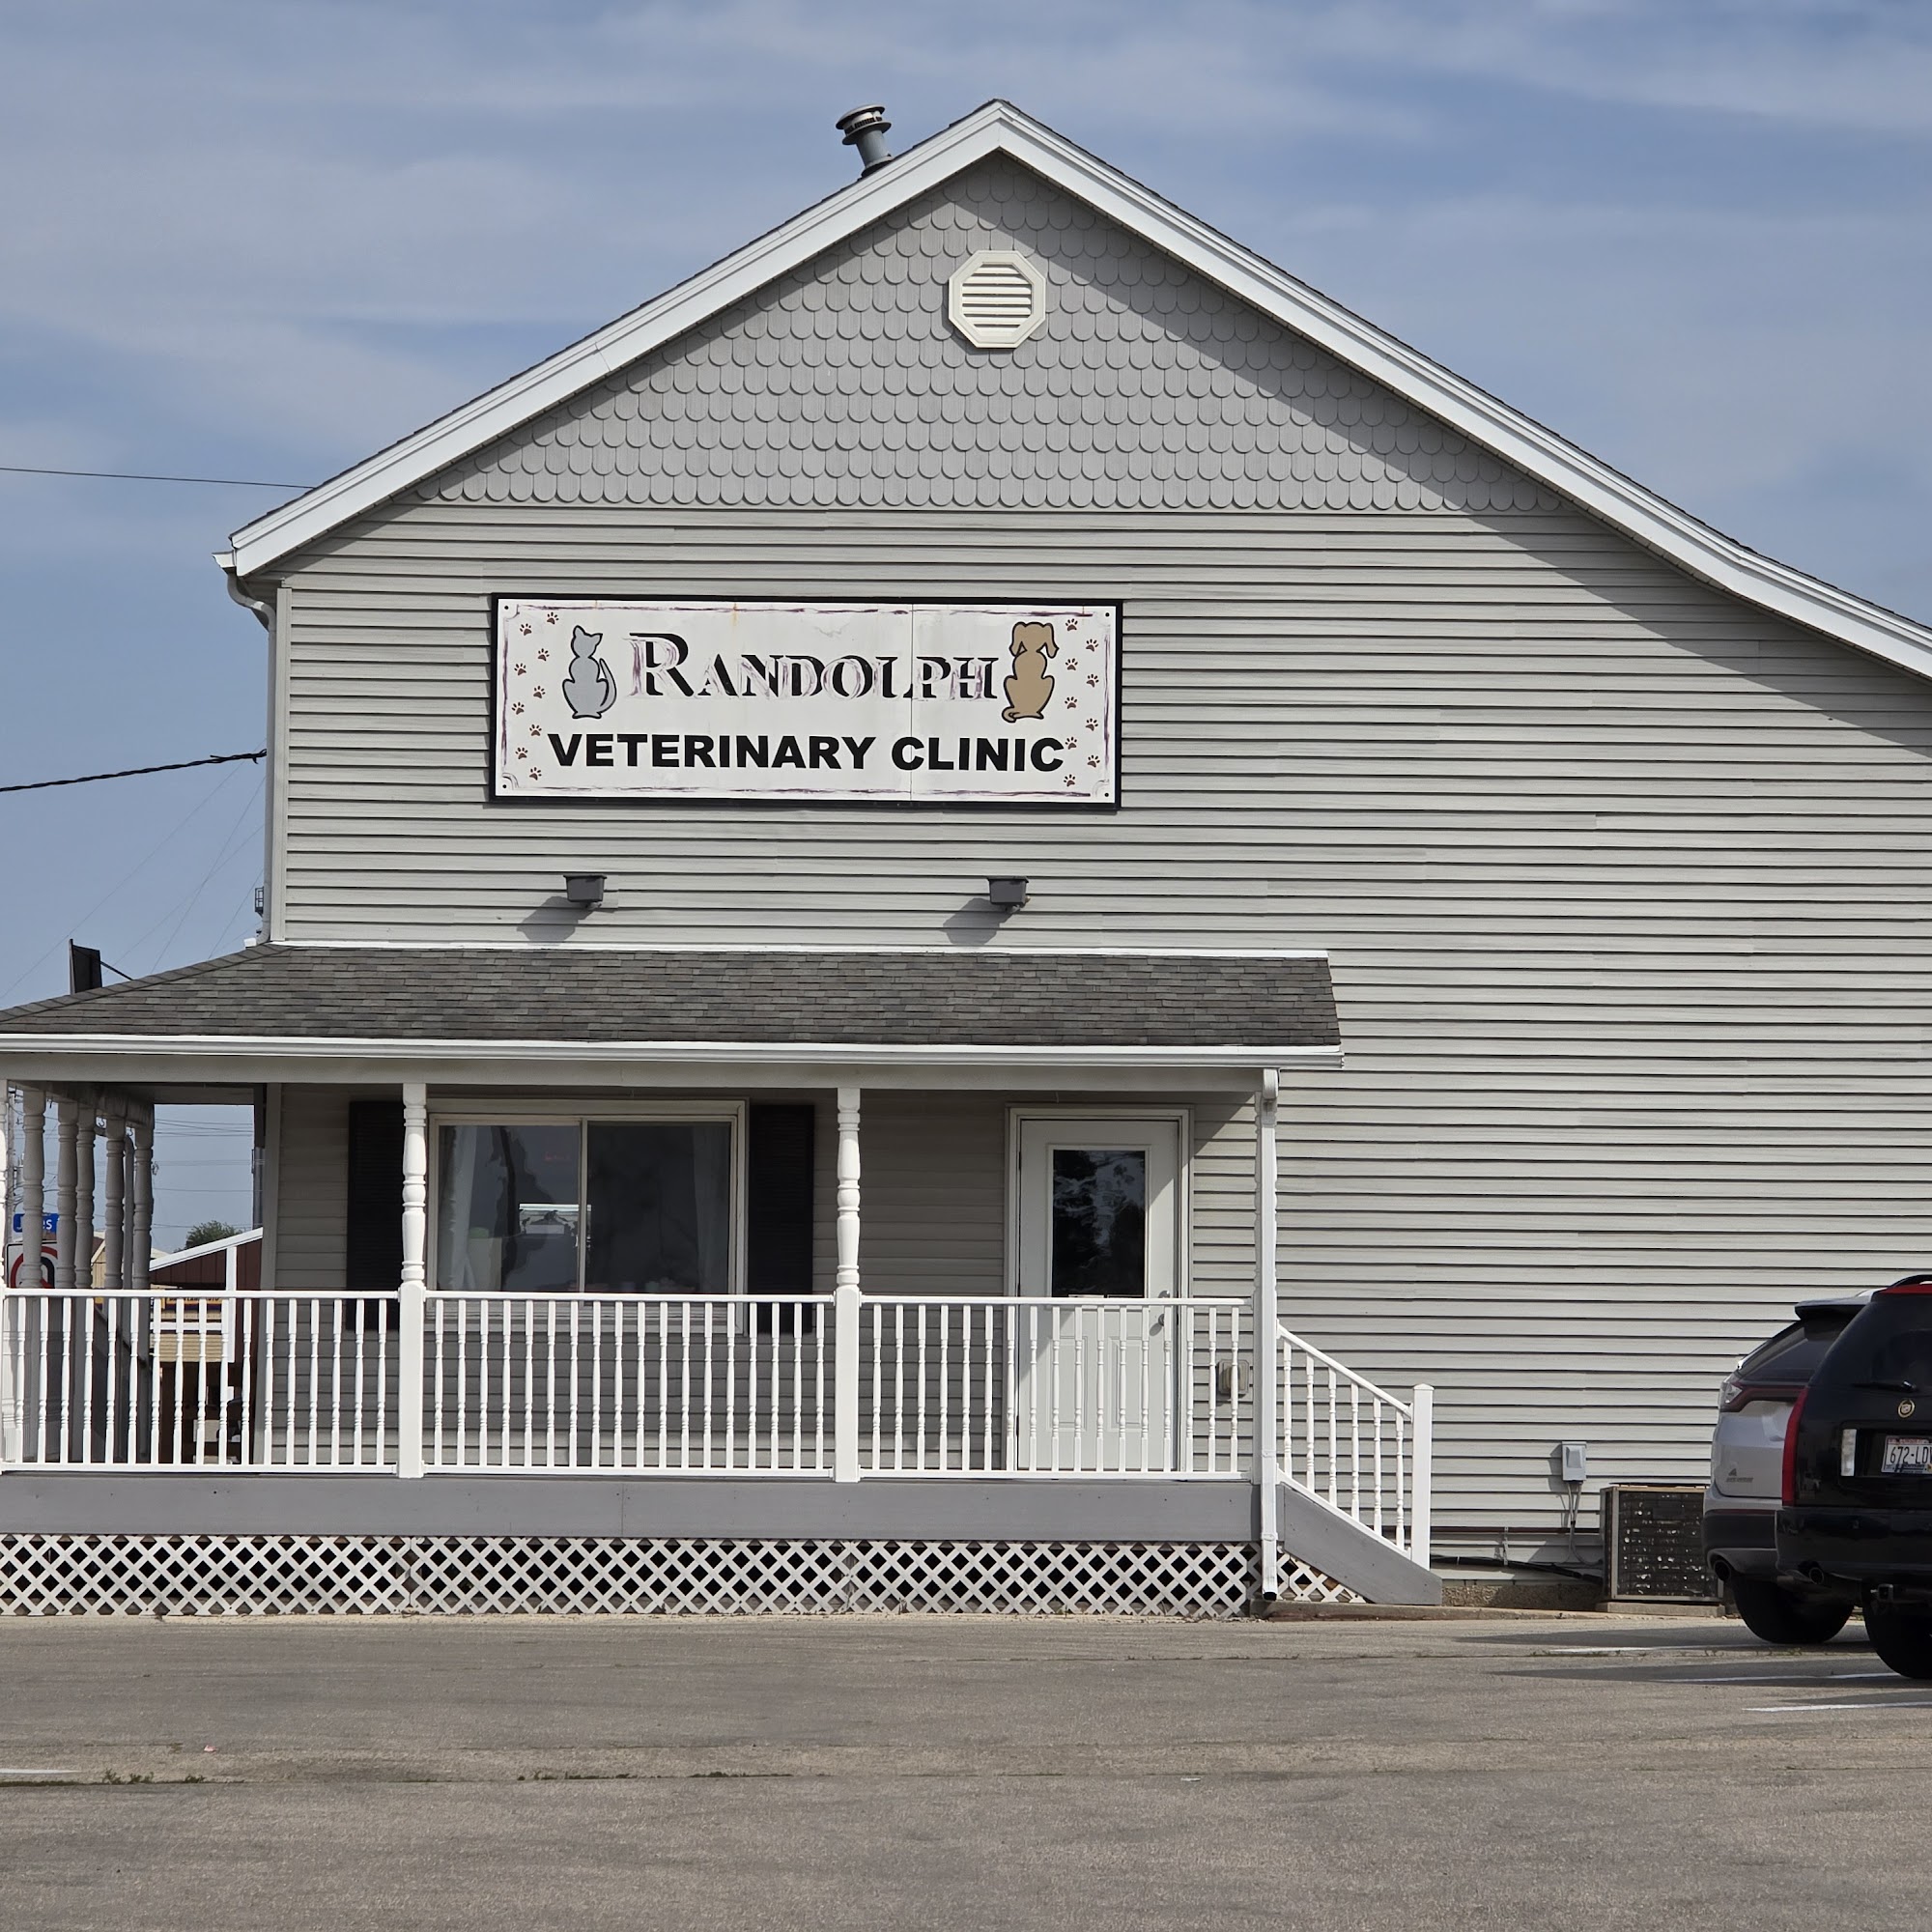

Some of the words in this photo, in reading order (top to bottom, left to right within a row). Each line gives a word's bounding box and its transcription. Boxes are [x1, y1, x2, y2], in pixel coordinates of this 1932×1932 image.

[624, 632, 999, 701] RANDOLPH
[547, 733, 876, 770] VETERINARY
[891, 736, 1065, 772] CLINIC
[1889, 1446, 1932, 1464] 672-LD
